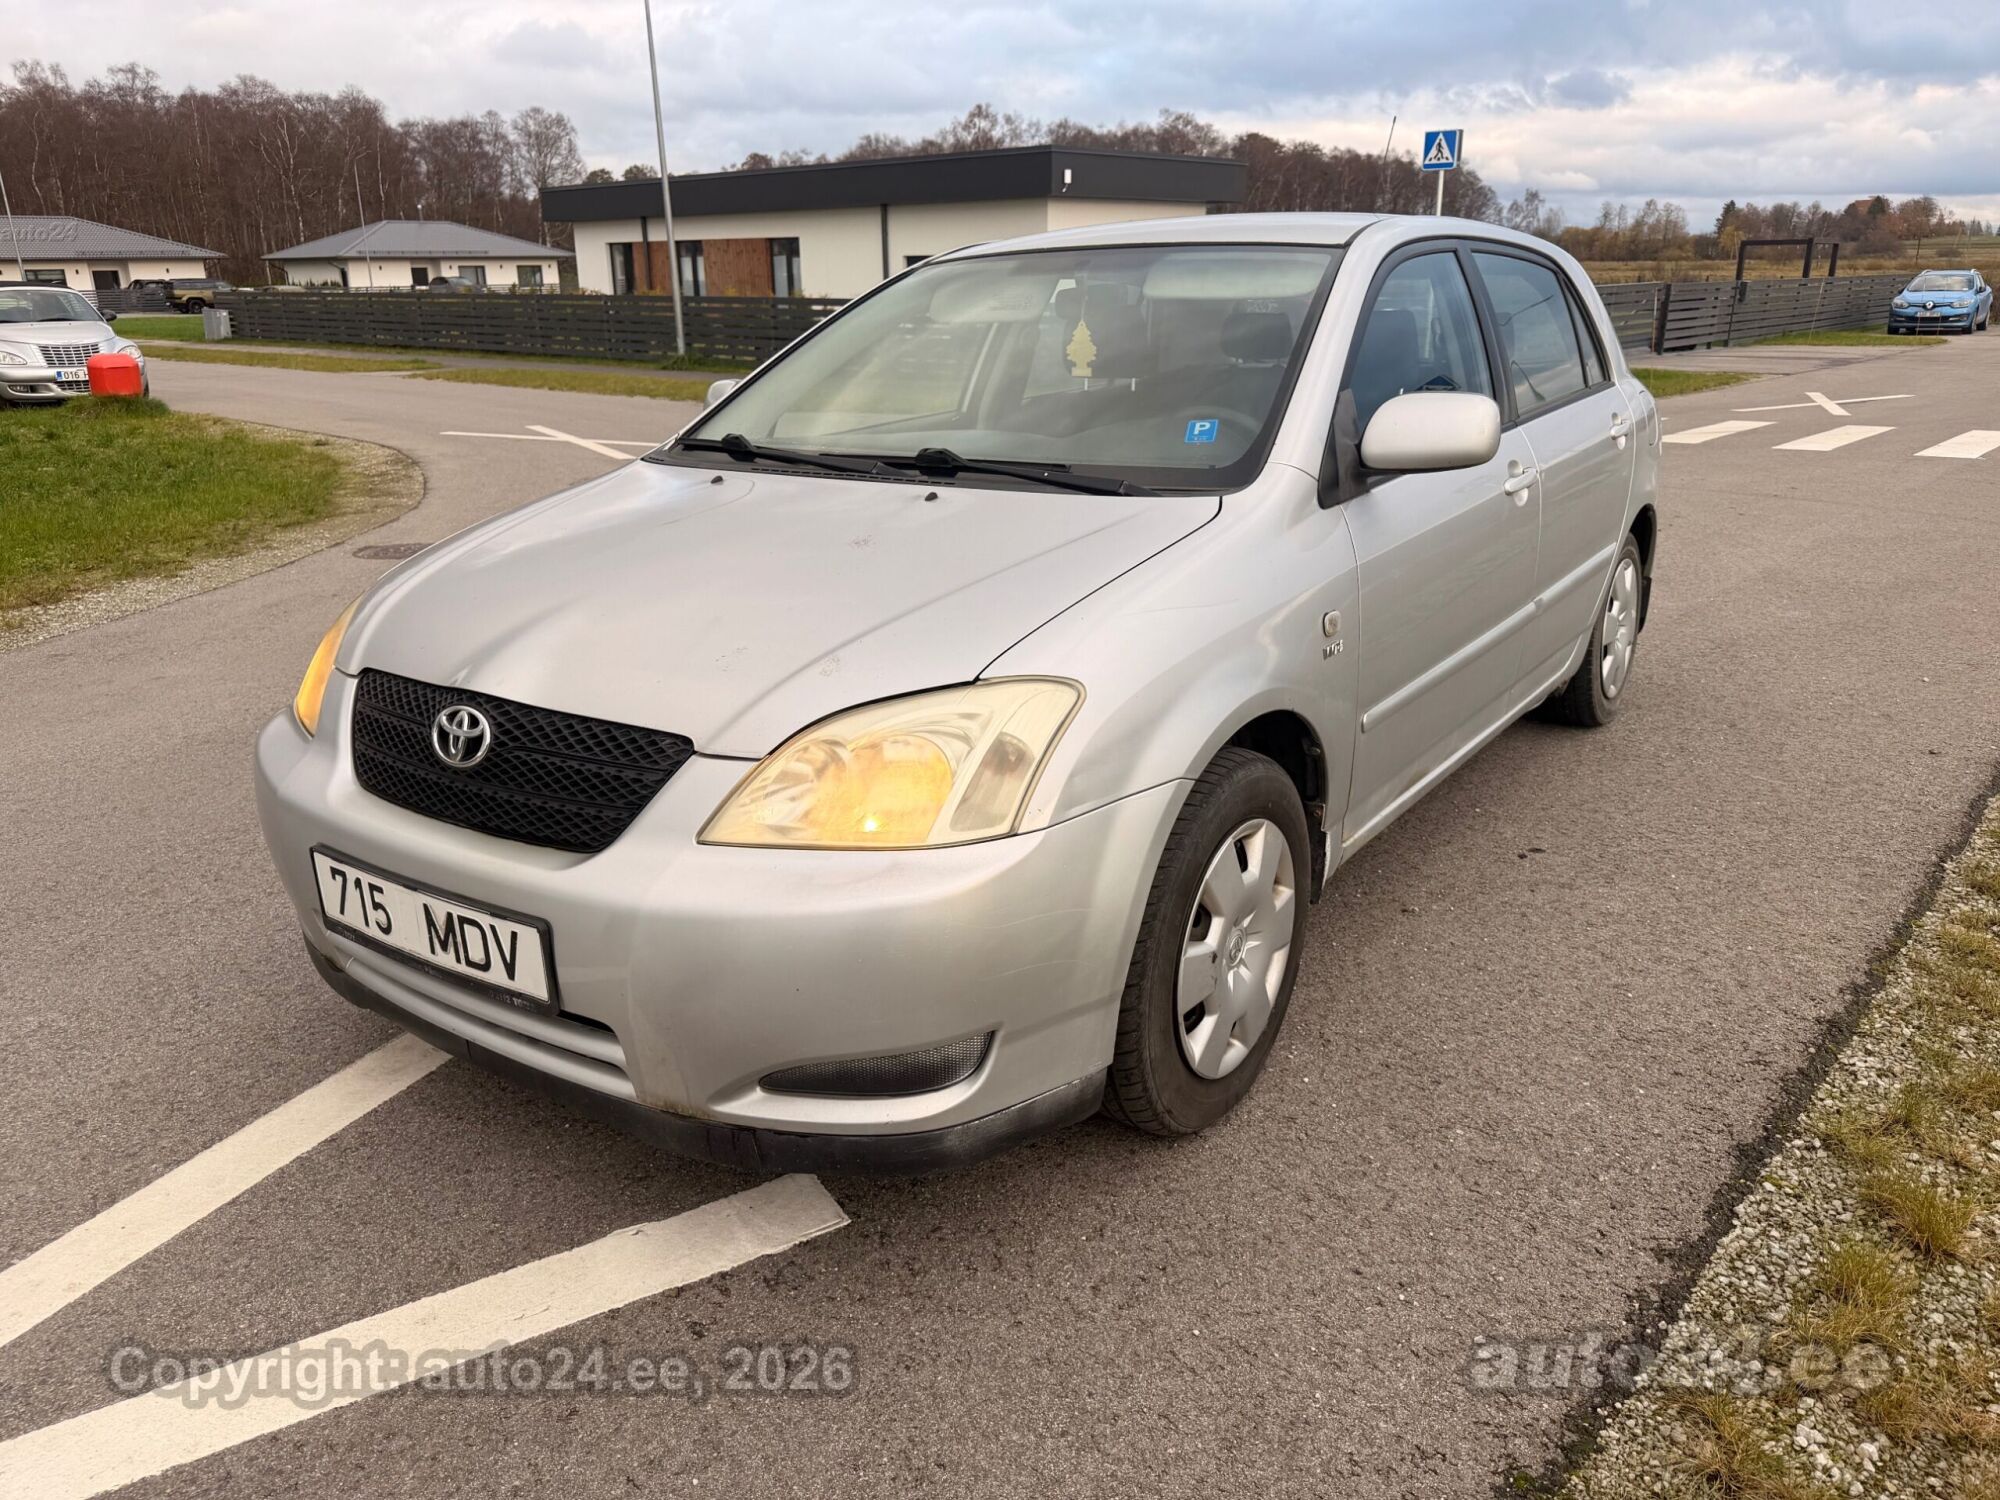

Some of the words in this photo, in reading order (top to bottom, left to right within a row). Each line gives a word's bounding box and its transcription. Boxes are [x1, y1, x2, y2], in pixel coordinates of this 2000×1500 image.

[63, 370, 80, 380] 016
[1193, 422, 1211, 435] P
[329, 865, 393, 936] 715
[422, 902, 519, 982] MDV
